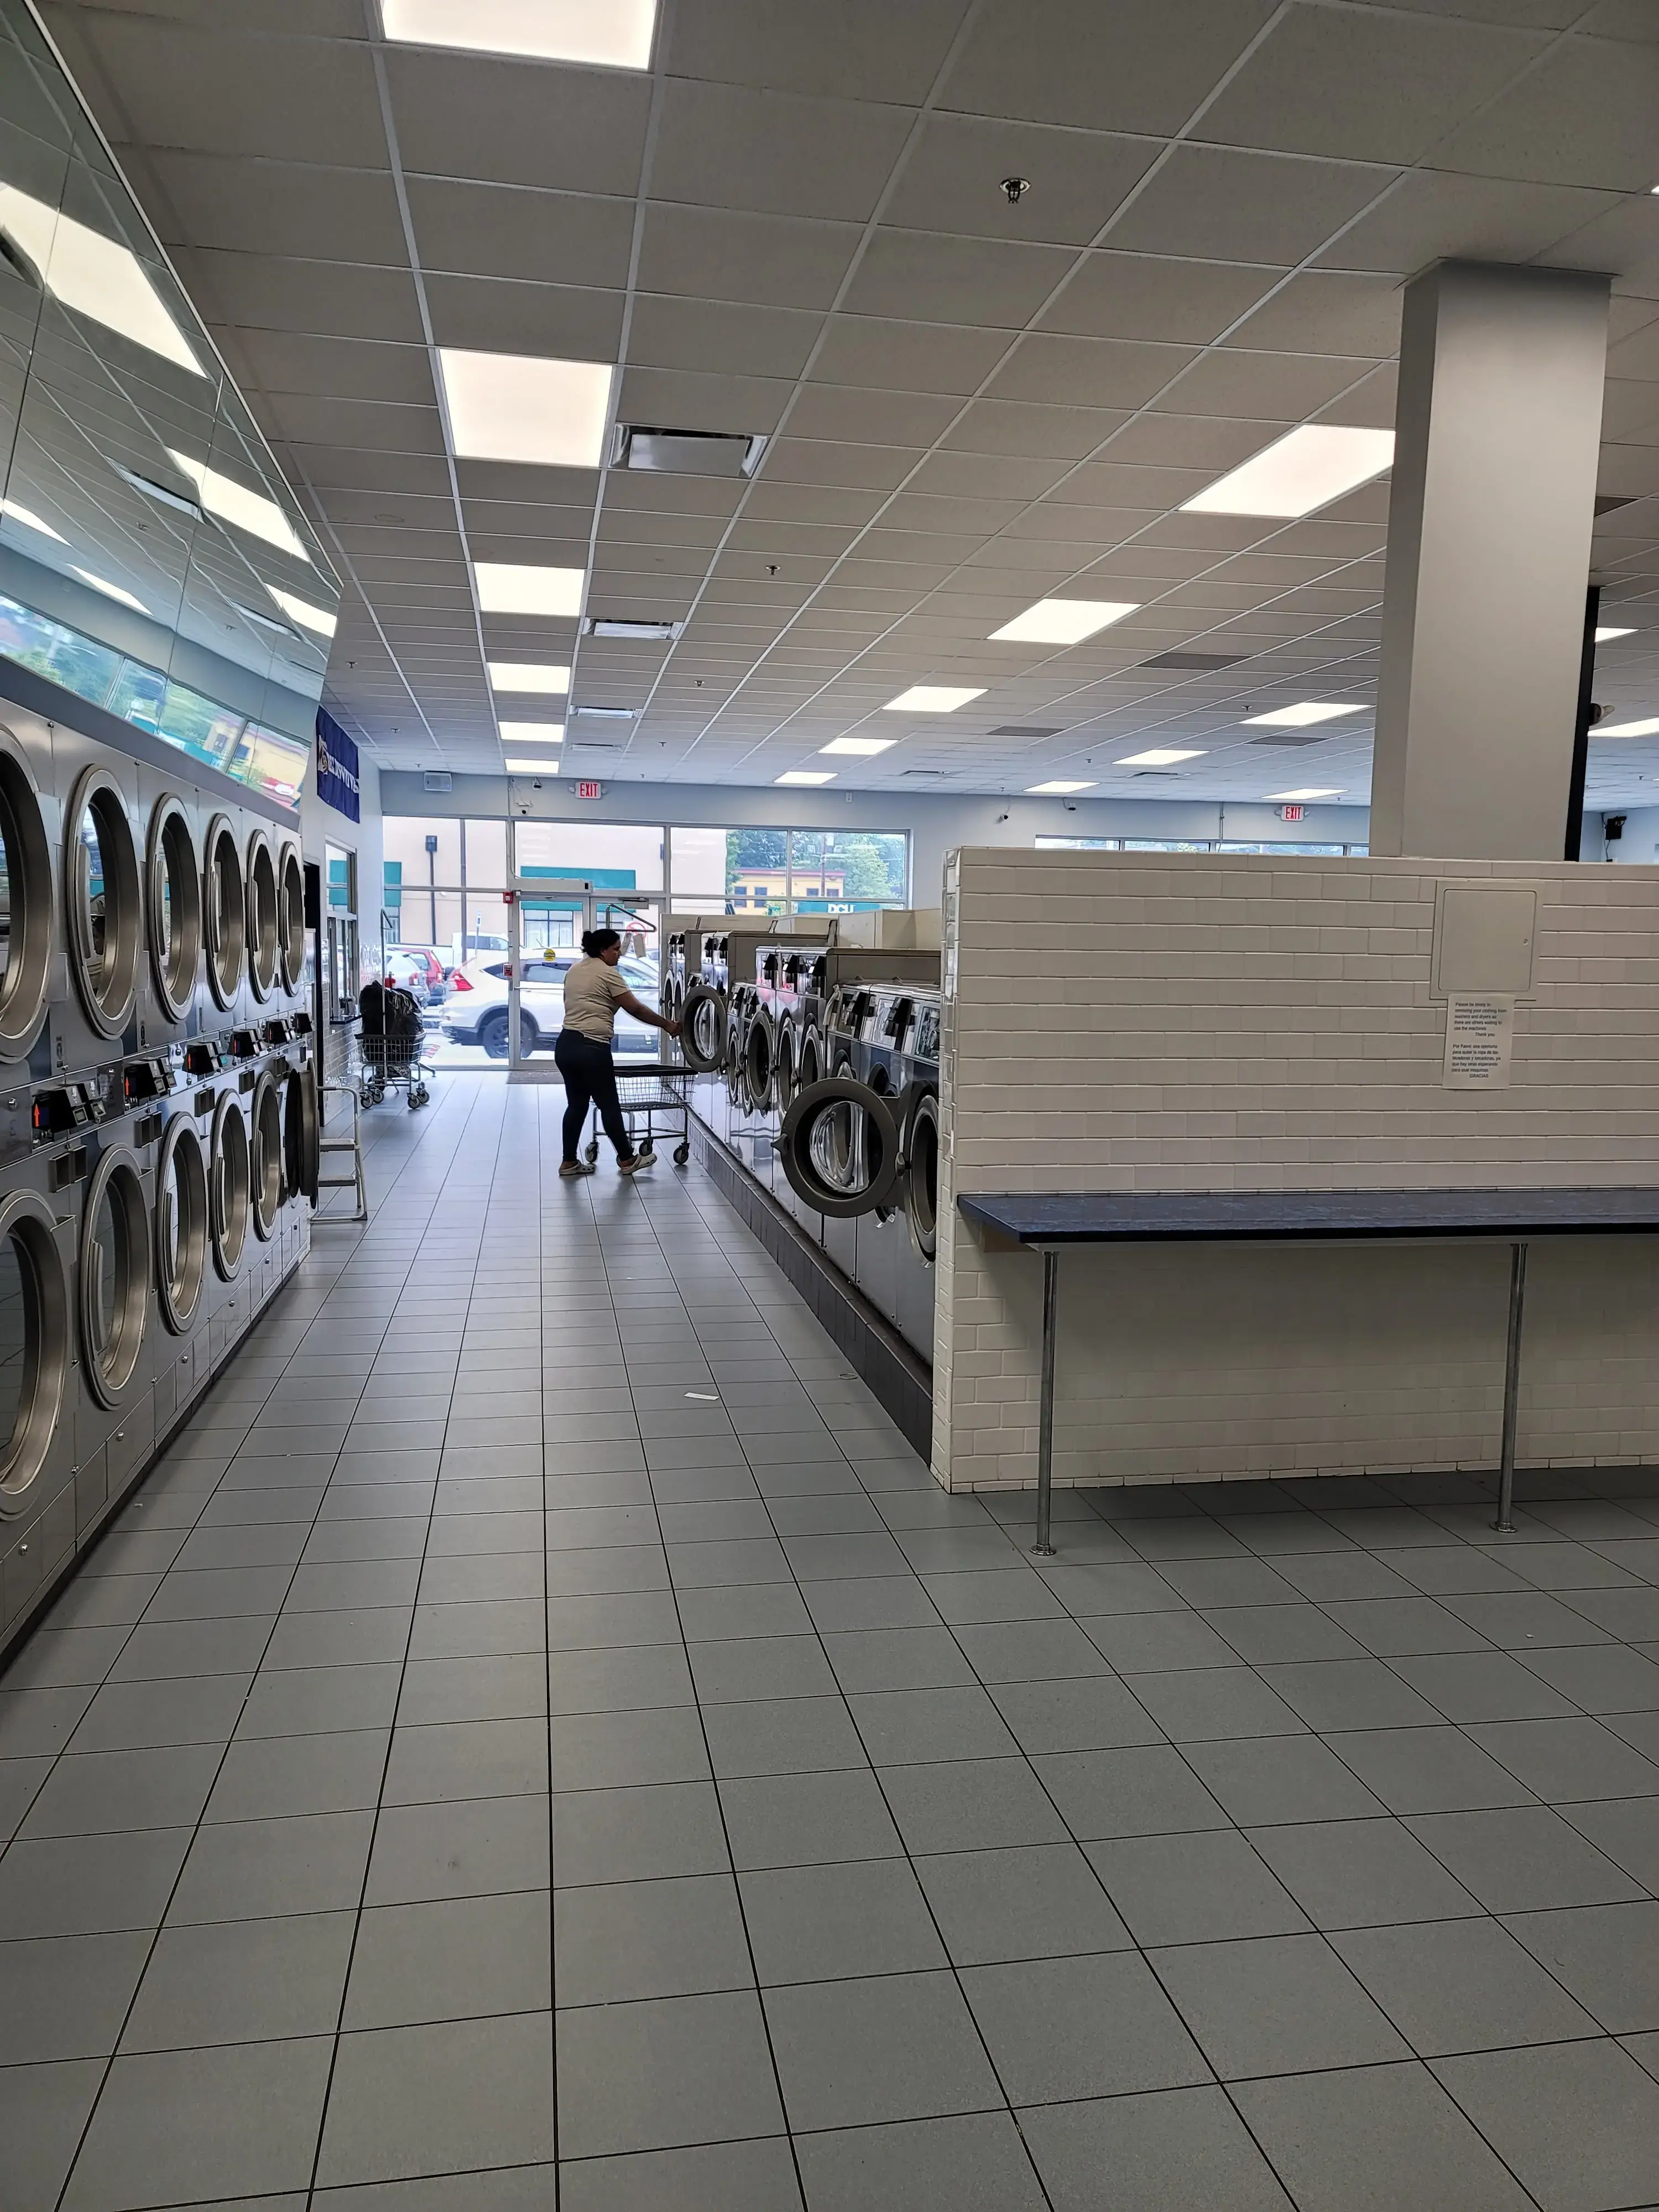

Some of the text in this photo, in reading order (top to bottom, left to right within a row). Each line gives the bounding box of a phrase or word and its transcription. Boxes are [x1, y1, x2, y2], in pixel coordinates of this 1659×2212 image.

[580, 782, 598, 797] EXIT
[1286, 806, 1301, 820] EXIT
[828, 904, 854, 914] DCU
